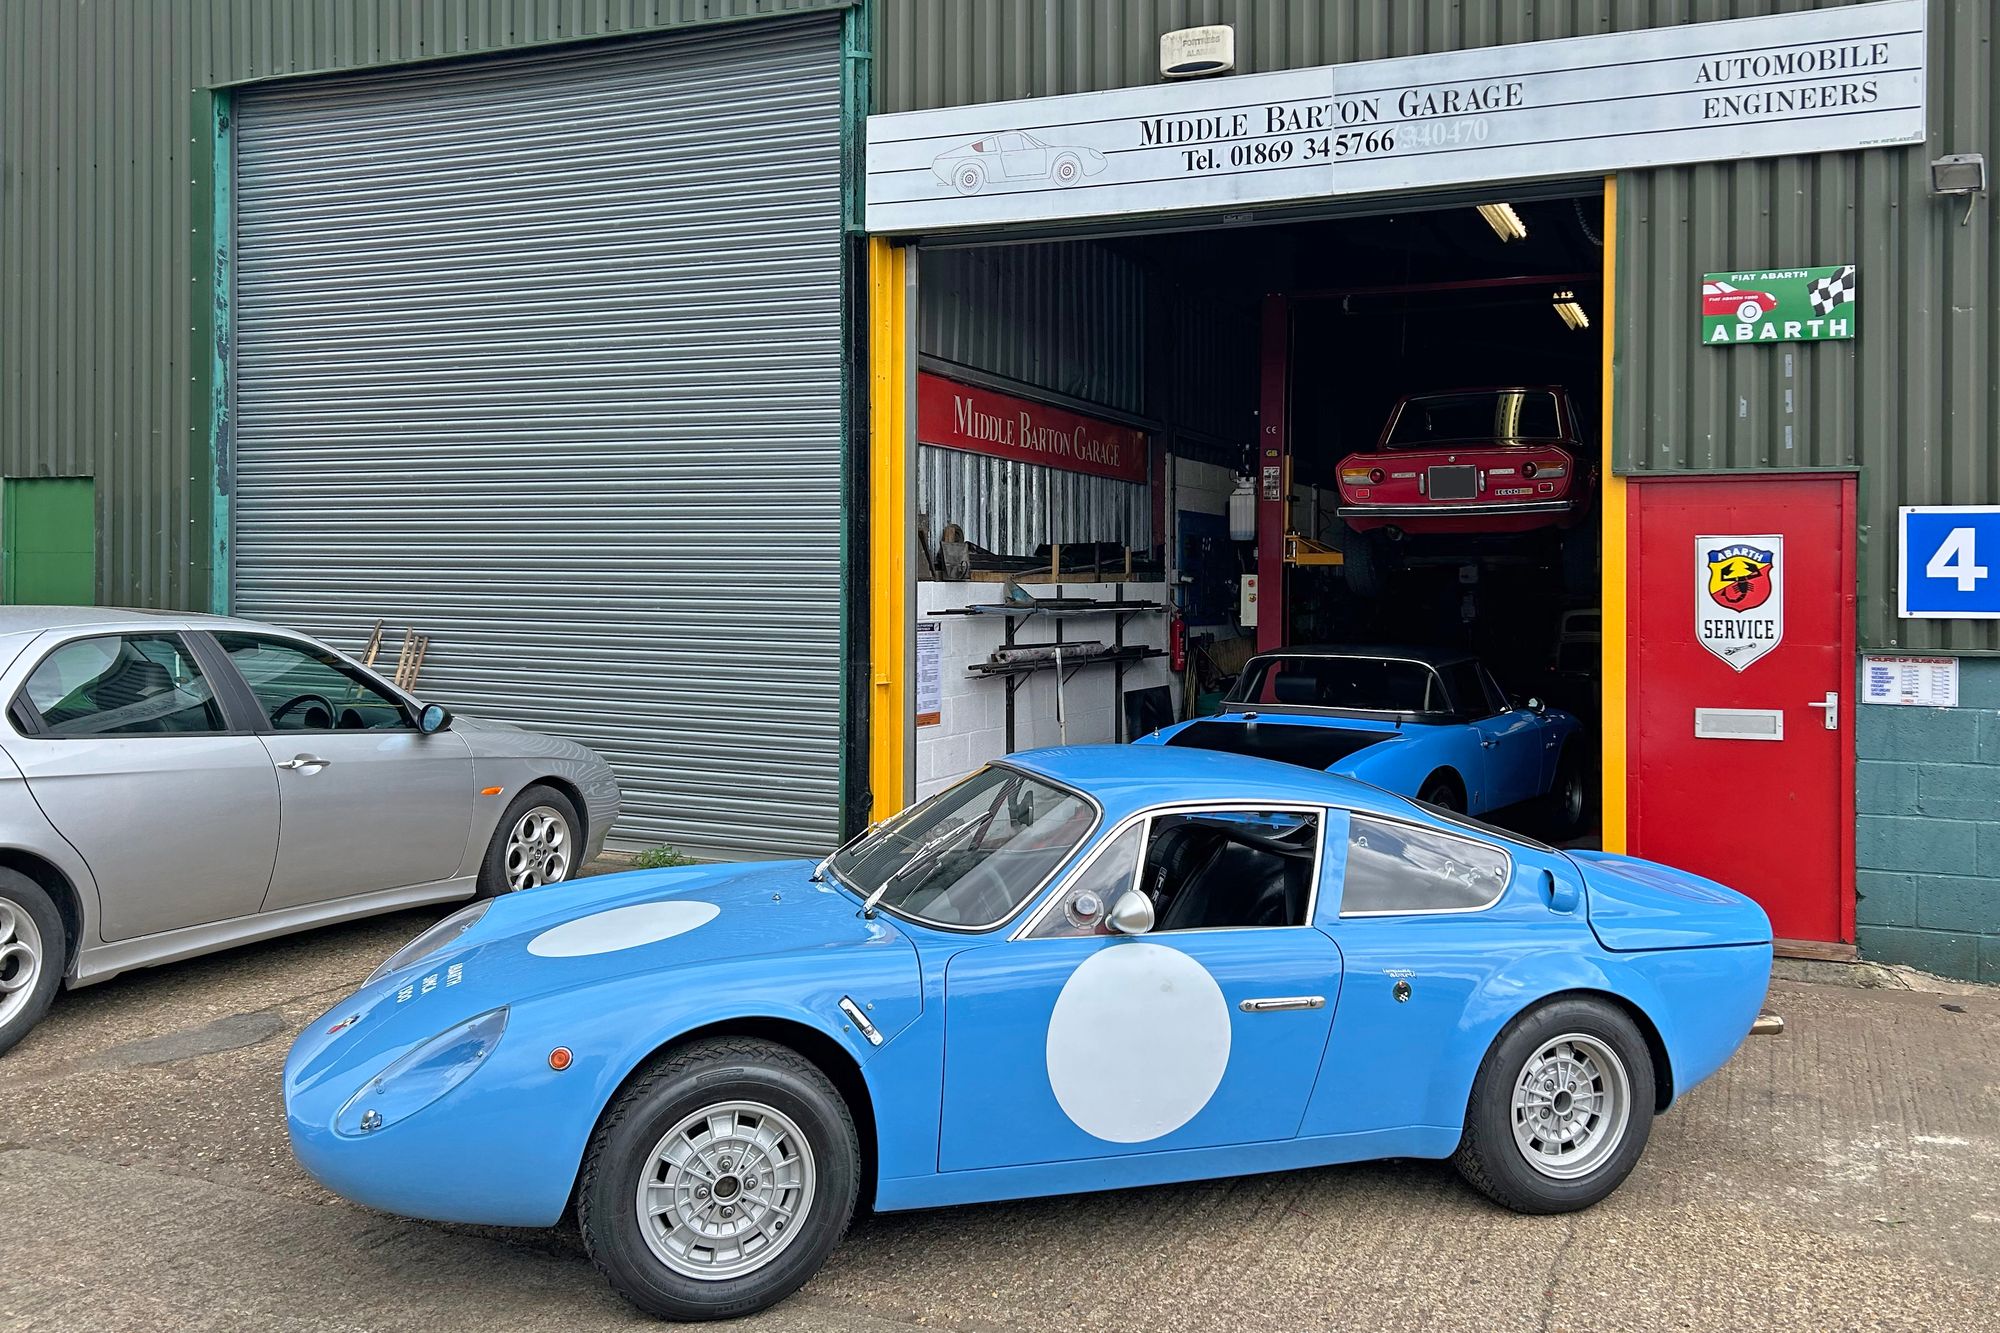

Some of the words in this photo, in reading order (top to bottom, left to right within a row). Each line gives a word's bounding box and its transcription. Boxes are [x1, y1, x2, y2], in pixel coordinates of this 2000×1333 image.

[1694, 42, 1889, 84] AUTOMOBILE
[1139, 113, 1248, 146] MIDDLE
[1264, 97, 1381, 133] BARTON
[1398, 82, 1523, 118] GARAGE
[1702, 81, 1878, 119] ENGINEERS
[1181, 148, 1221, 171] Tel.
[1230, 140, 1294, 167] 01869
[1731, 273, 1756, 282] FIAT
[1760, 271, 1808, 280] ABARTH
[1710, 319, 1847, 342] ABARTH
[953, 395, 1015, 446] MIDDLE
[1019, 411, 1071, 457] BARTON
[1074, 426, 1121, 467] GARAGE
[1717, 547, 1763, 561] ABARTH
[1926, 527, 1988, 592] 4
[1704, 619, 1774, 639] SERVICE
